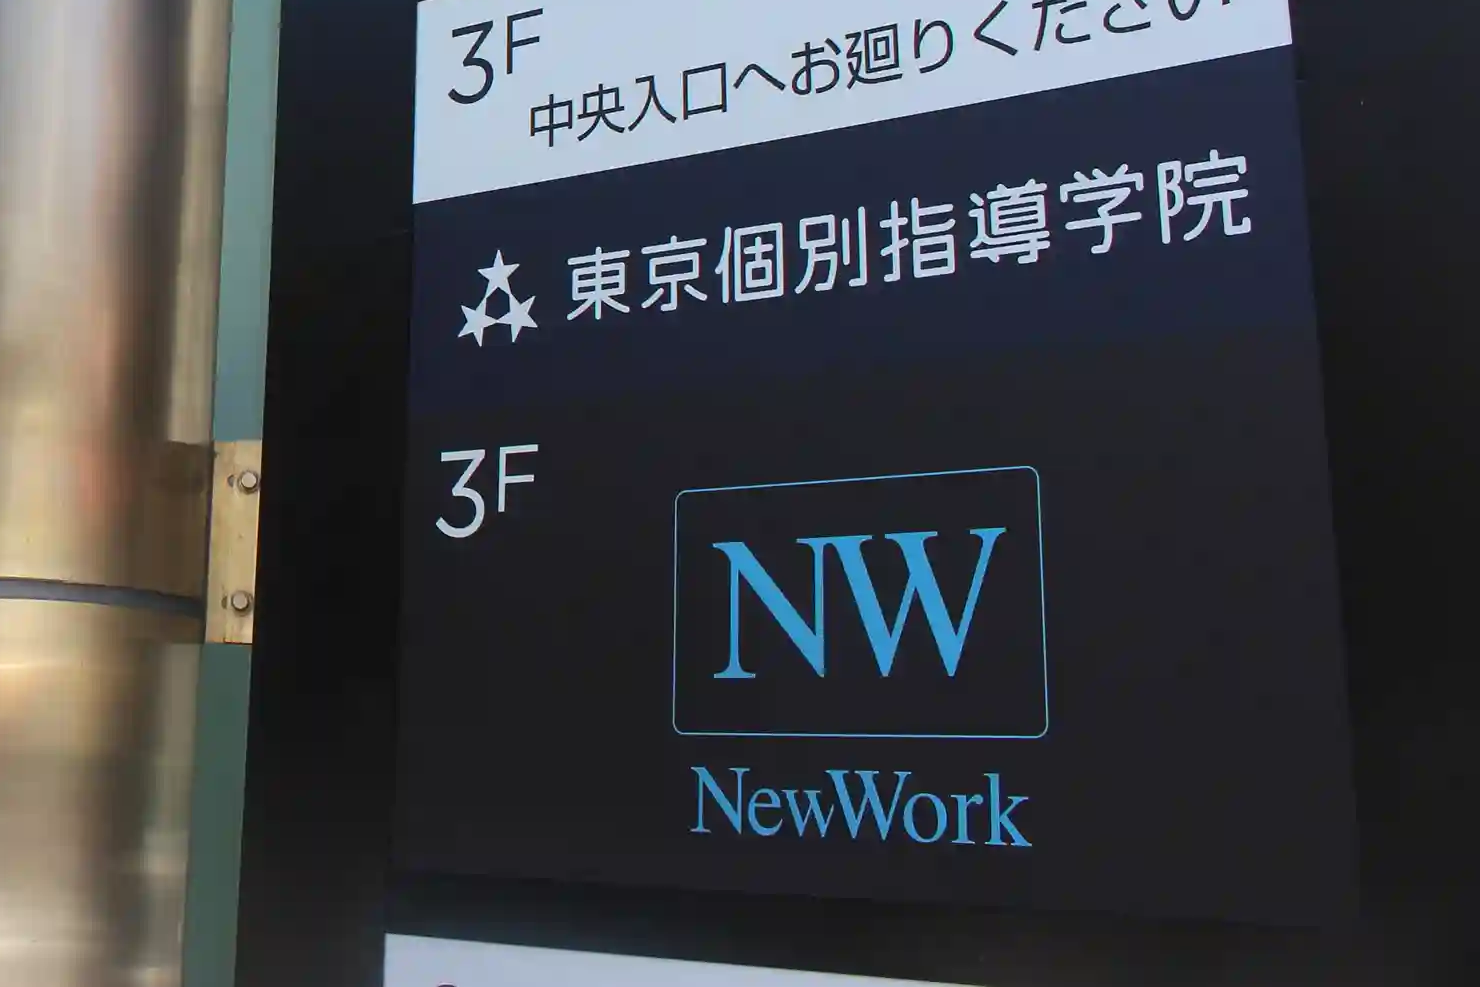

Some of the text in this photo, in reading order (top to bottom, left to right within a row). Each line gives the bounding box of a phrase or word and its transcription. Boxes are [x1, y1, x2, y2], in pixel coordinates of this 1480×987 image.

[448, 8, 543, 104] 3F
[567, 149, 1251, 320] 東京個別指導学院
[436, 444, 538, 538] 3F
[713, 528, 1006, 678] NW
[691, 767, 1032, 846] NewWork
